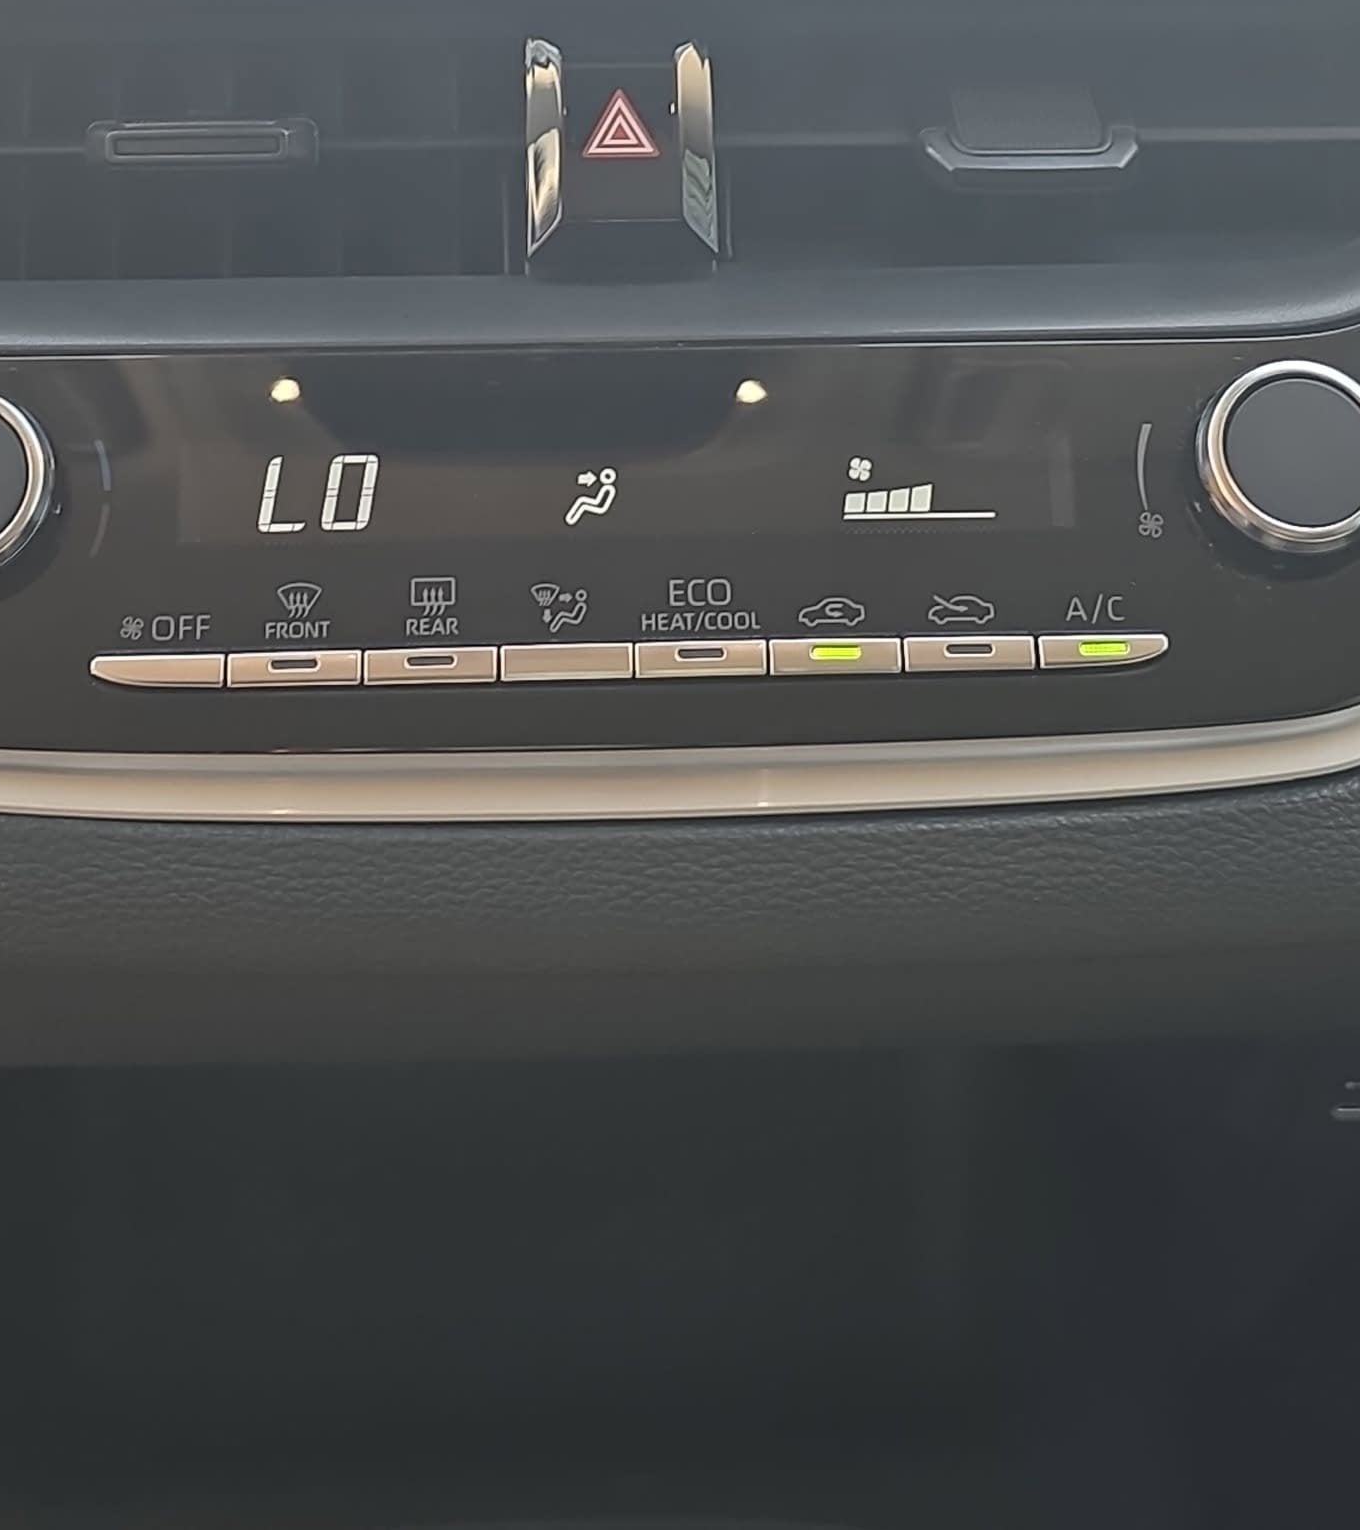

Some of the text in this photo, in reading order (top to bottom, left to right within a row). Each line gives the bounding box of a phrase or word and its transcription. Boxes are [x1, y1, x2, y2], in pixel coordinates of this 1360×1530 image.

[257, 453, 380, 534] LO
[667, 577, 733, 608] ECO
[641, 610, 762, 634] HEAT/COOL
[1065, 592, 1127, 625] A/C
[150, 613, 212, 642] OFF
[264, 619, 332, 641] FRONT
[405, 616, 461, 638] REAR
